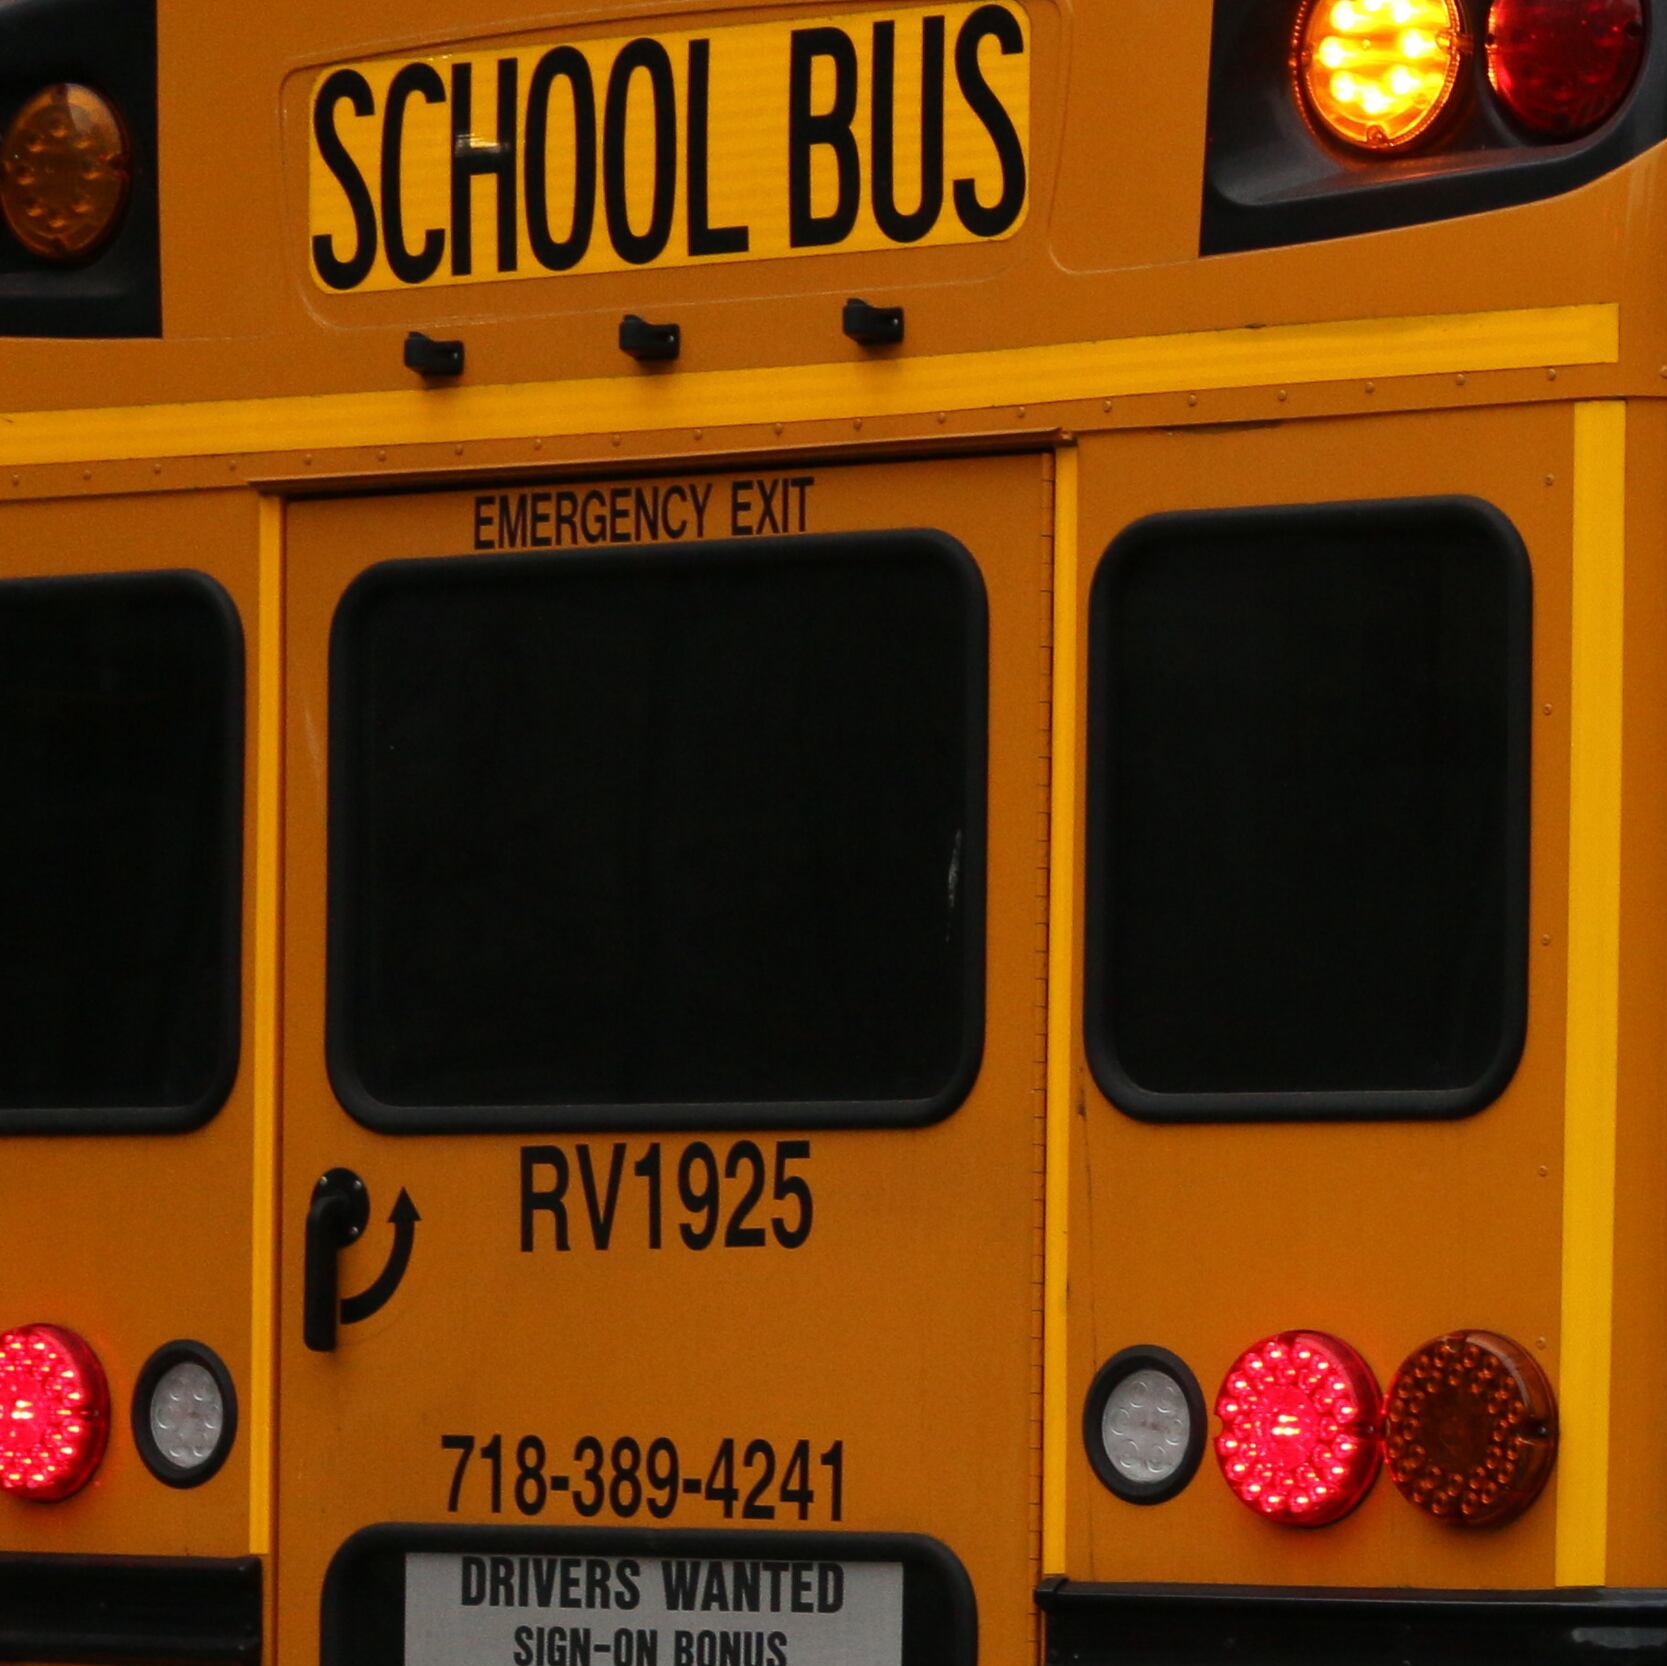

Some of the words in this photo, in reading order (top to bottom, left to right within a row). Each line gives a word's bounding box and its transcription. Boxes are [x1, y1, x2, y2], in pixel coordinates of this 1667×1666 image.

[311, 37, 749, 290] SCHOOL
[788, 3, 1027, 249] BUS
[473, 484, 710, 552] EMERGENCY
[729, 477, 814, 537] EXIT
[519, 1140, 814, 1253] RV1925
[441, 1434, 843, 1521] 718-389-4241
[460, 1556, 641, 1609] DRIVERS
[662, 1560, 845, 1614] WANTED
